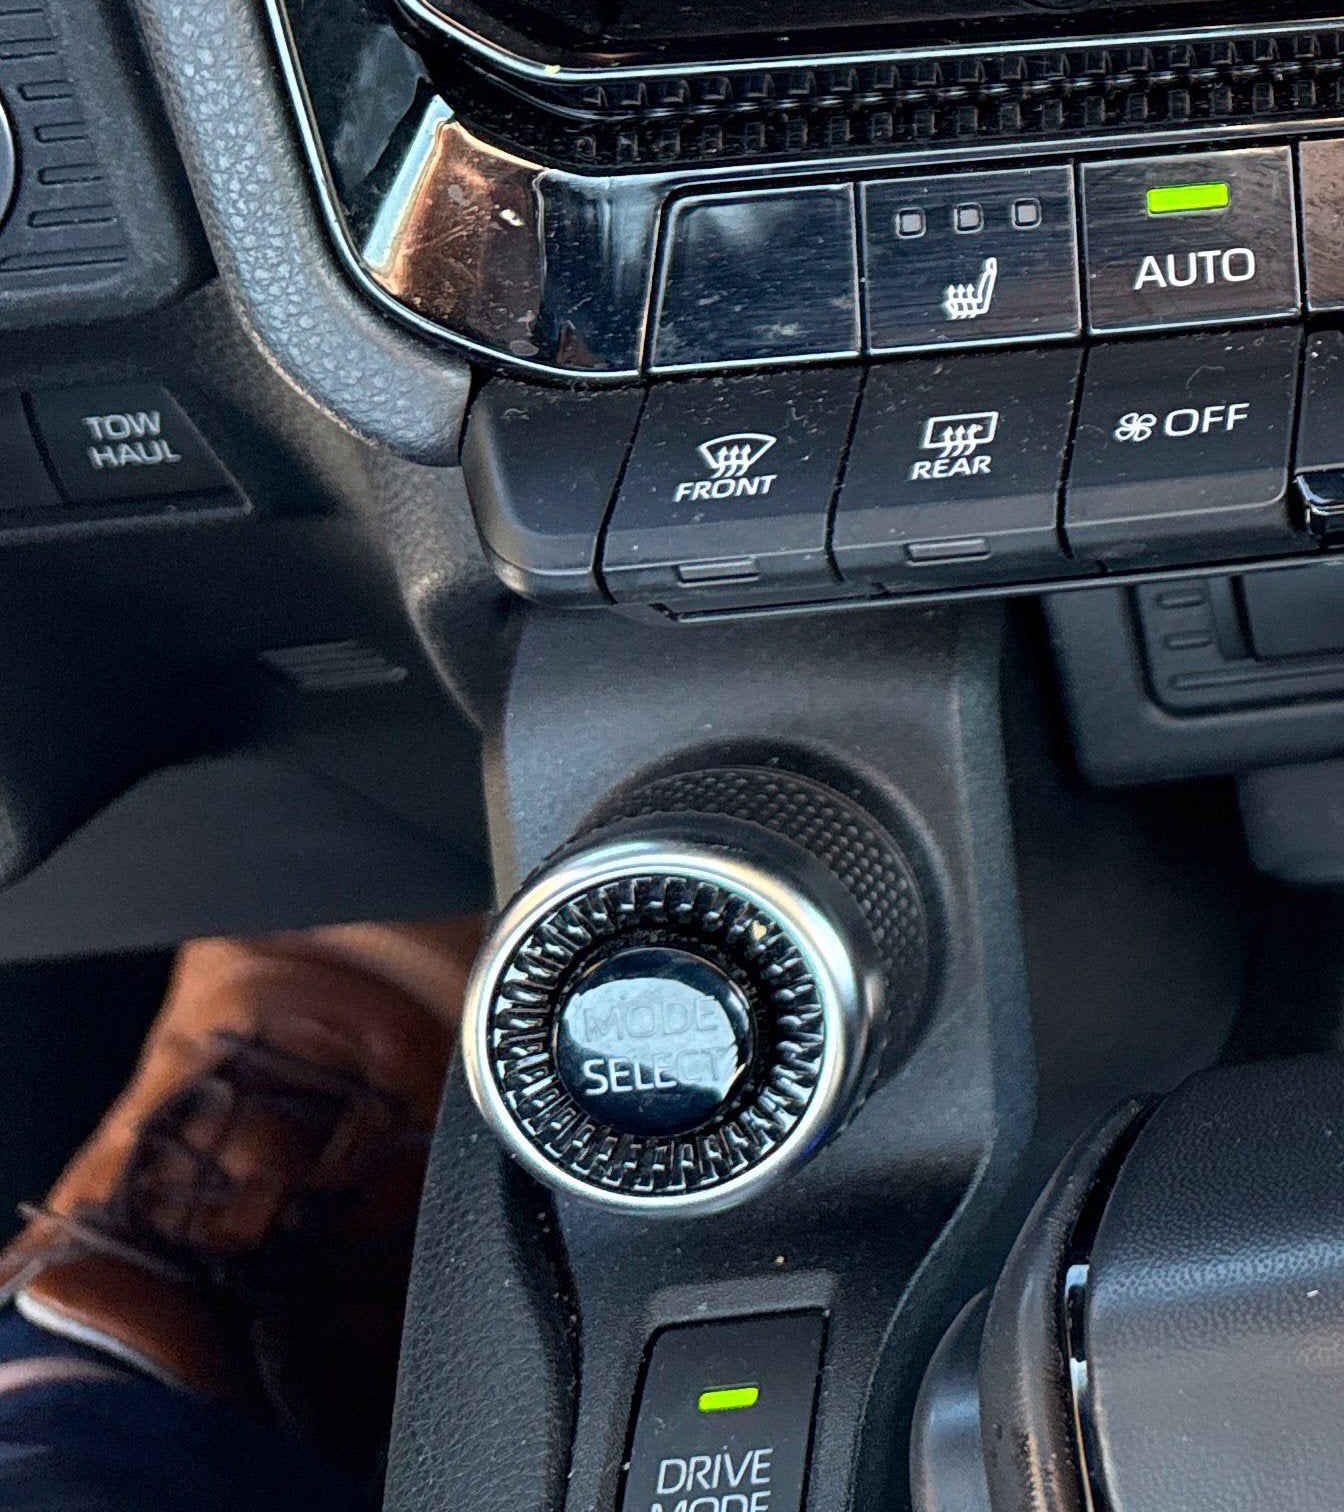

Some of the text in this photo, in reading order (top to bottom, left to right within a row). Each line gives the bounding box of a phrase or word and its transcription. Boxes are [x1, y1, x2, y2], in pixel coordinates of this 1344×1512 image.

[1133, 247, 1257, 290] AUTO
[82, 410, 161, 441] TOW
[1164, 402, 1250, 437] OFF
[87, 439, 182, 470] HAUL
[910, 455, 992, 480] REAR
[674, 472, 777, 503] FRONT
[582, 996, 719, 1042] MODE
[583, 1046, 727, 1096] SELECT
[656, 1448, 774, 1495] DRIVE
[650, 1490, 772, 1512] DE
